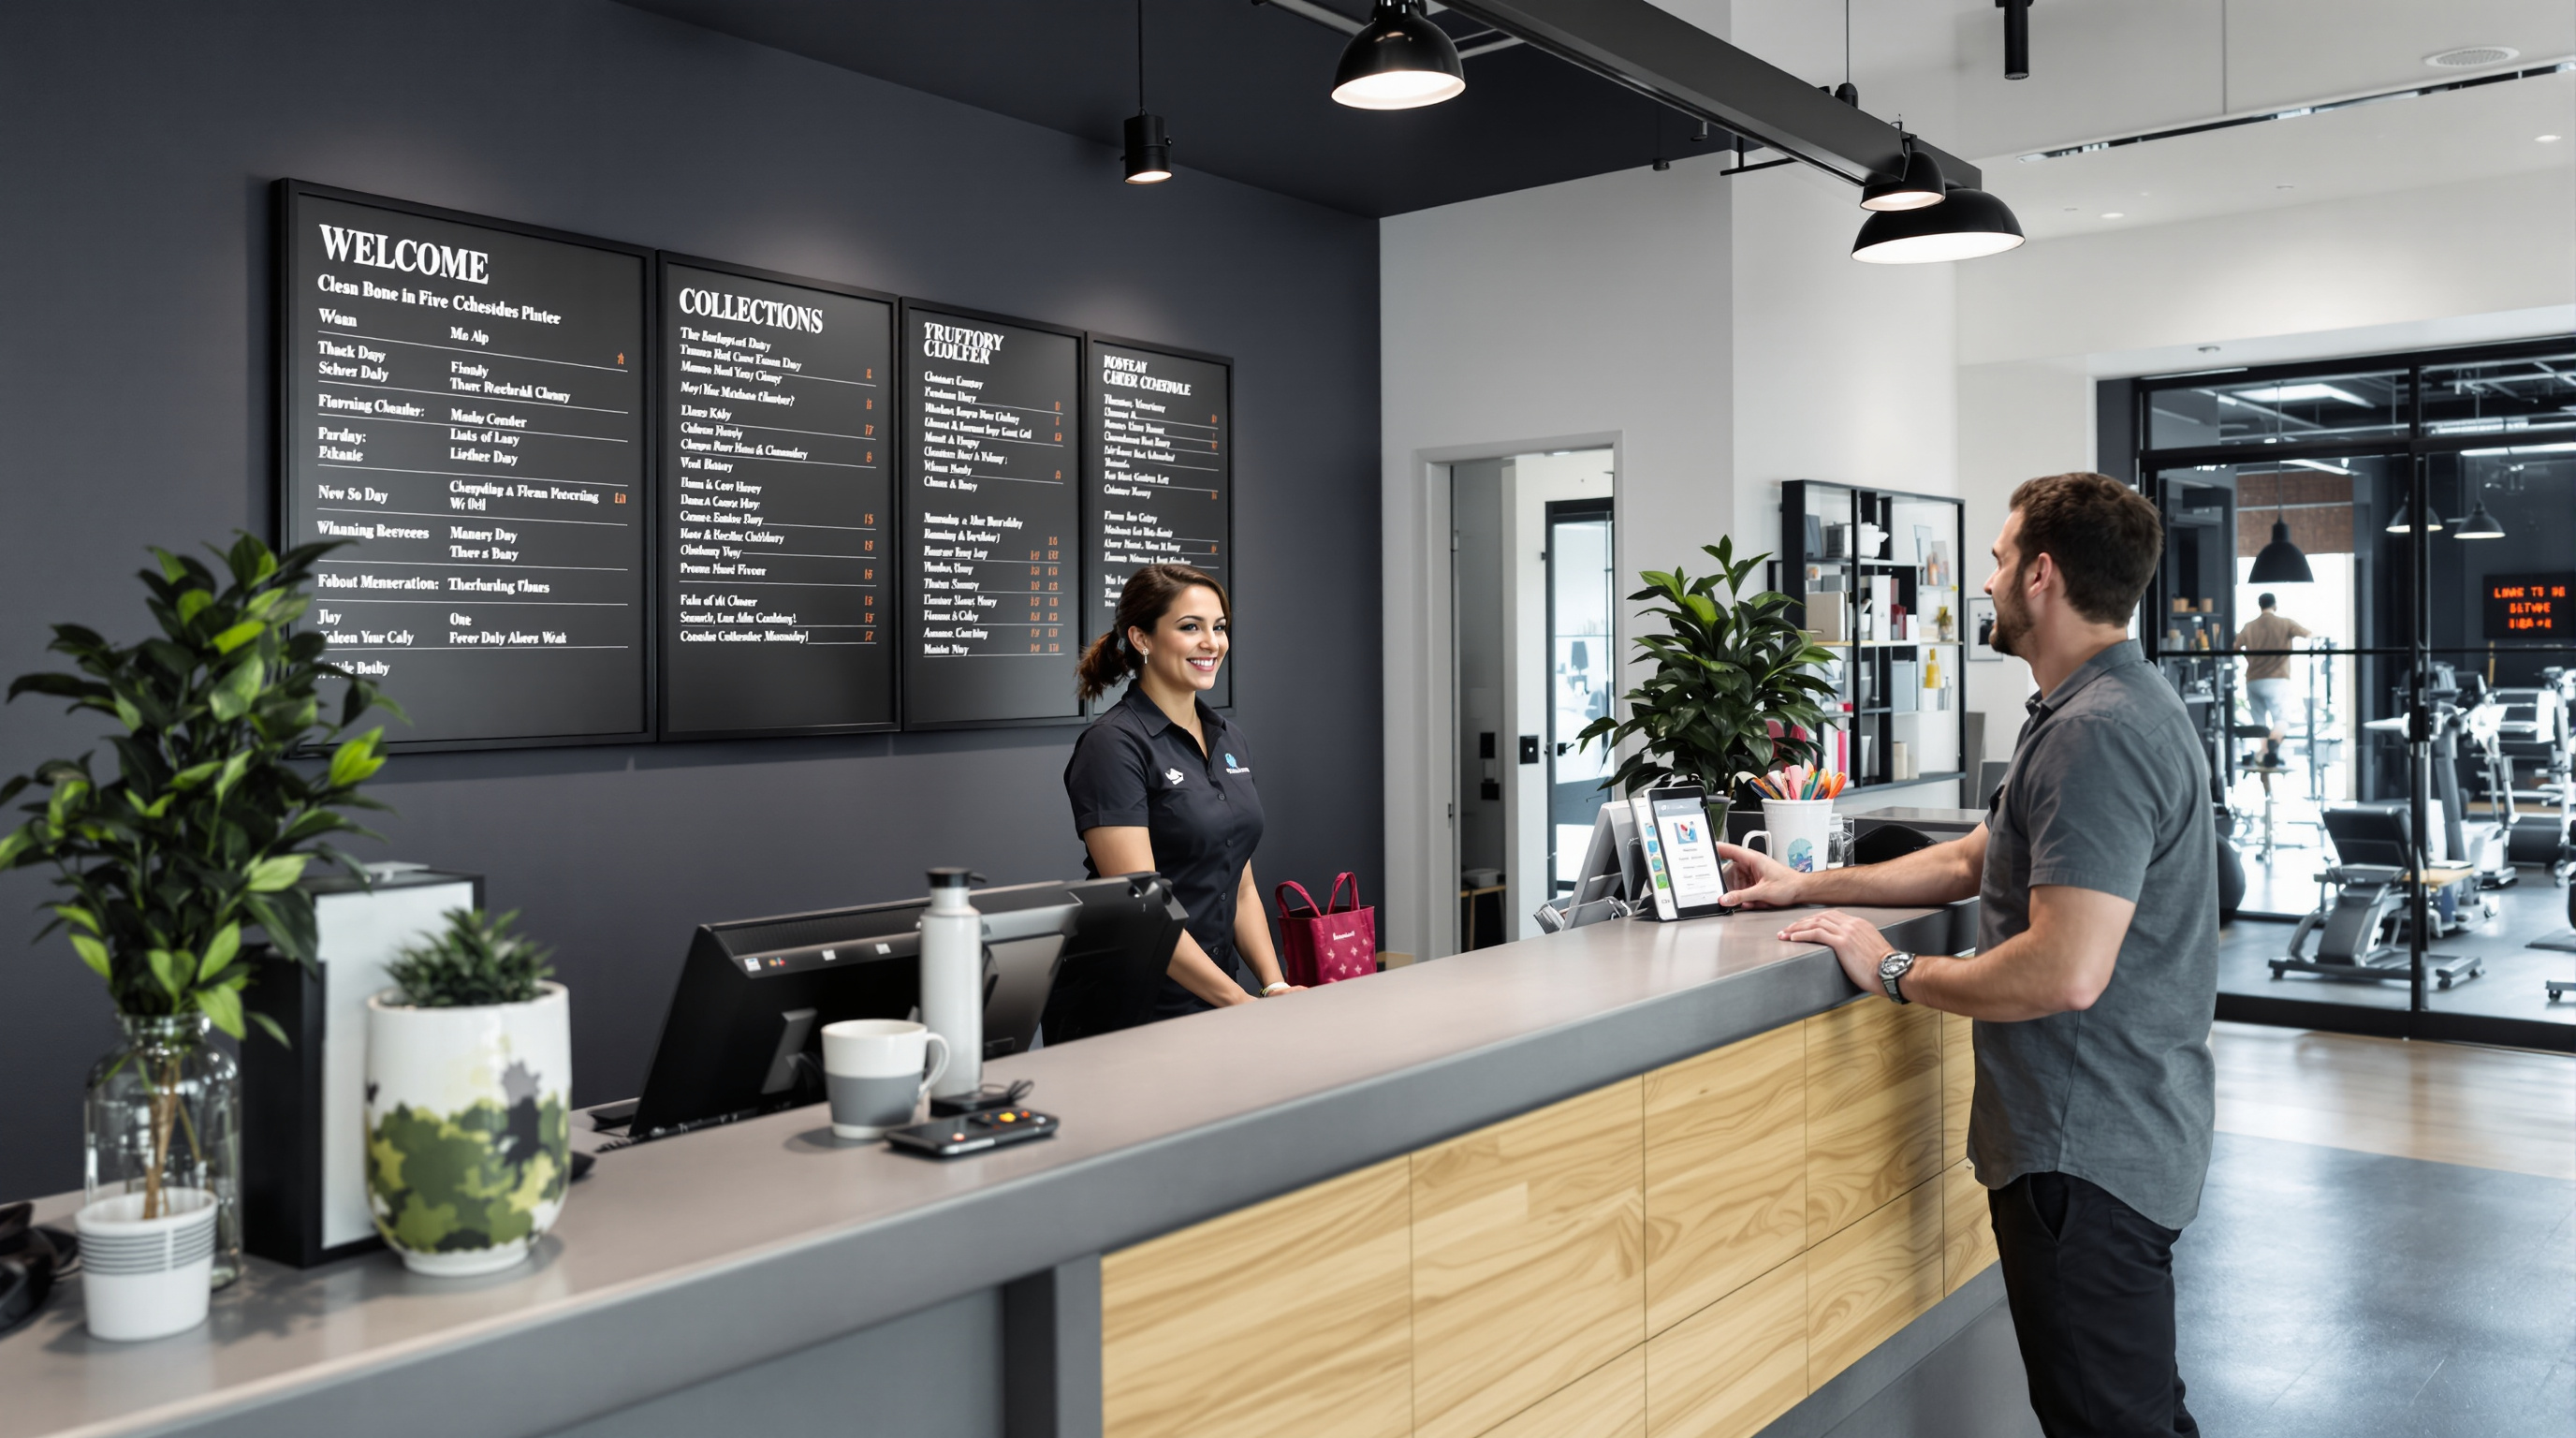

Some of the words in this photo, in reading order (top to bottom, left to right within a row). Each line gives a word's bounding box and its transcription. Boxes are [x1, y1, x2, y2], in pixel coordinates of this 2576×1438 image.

[319, 225, 489, 284] WELCOME
[363, 281, 398, 301] Bone
[402, 288, 416, 303] in
[419, 290, 448, 308] Five
[680, 288, 823, 333] COLLECTIONS
[481, 431, 492, 442] of
[365, 488, 388, 505] Day
